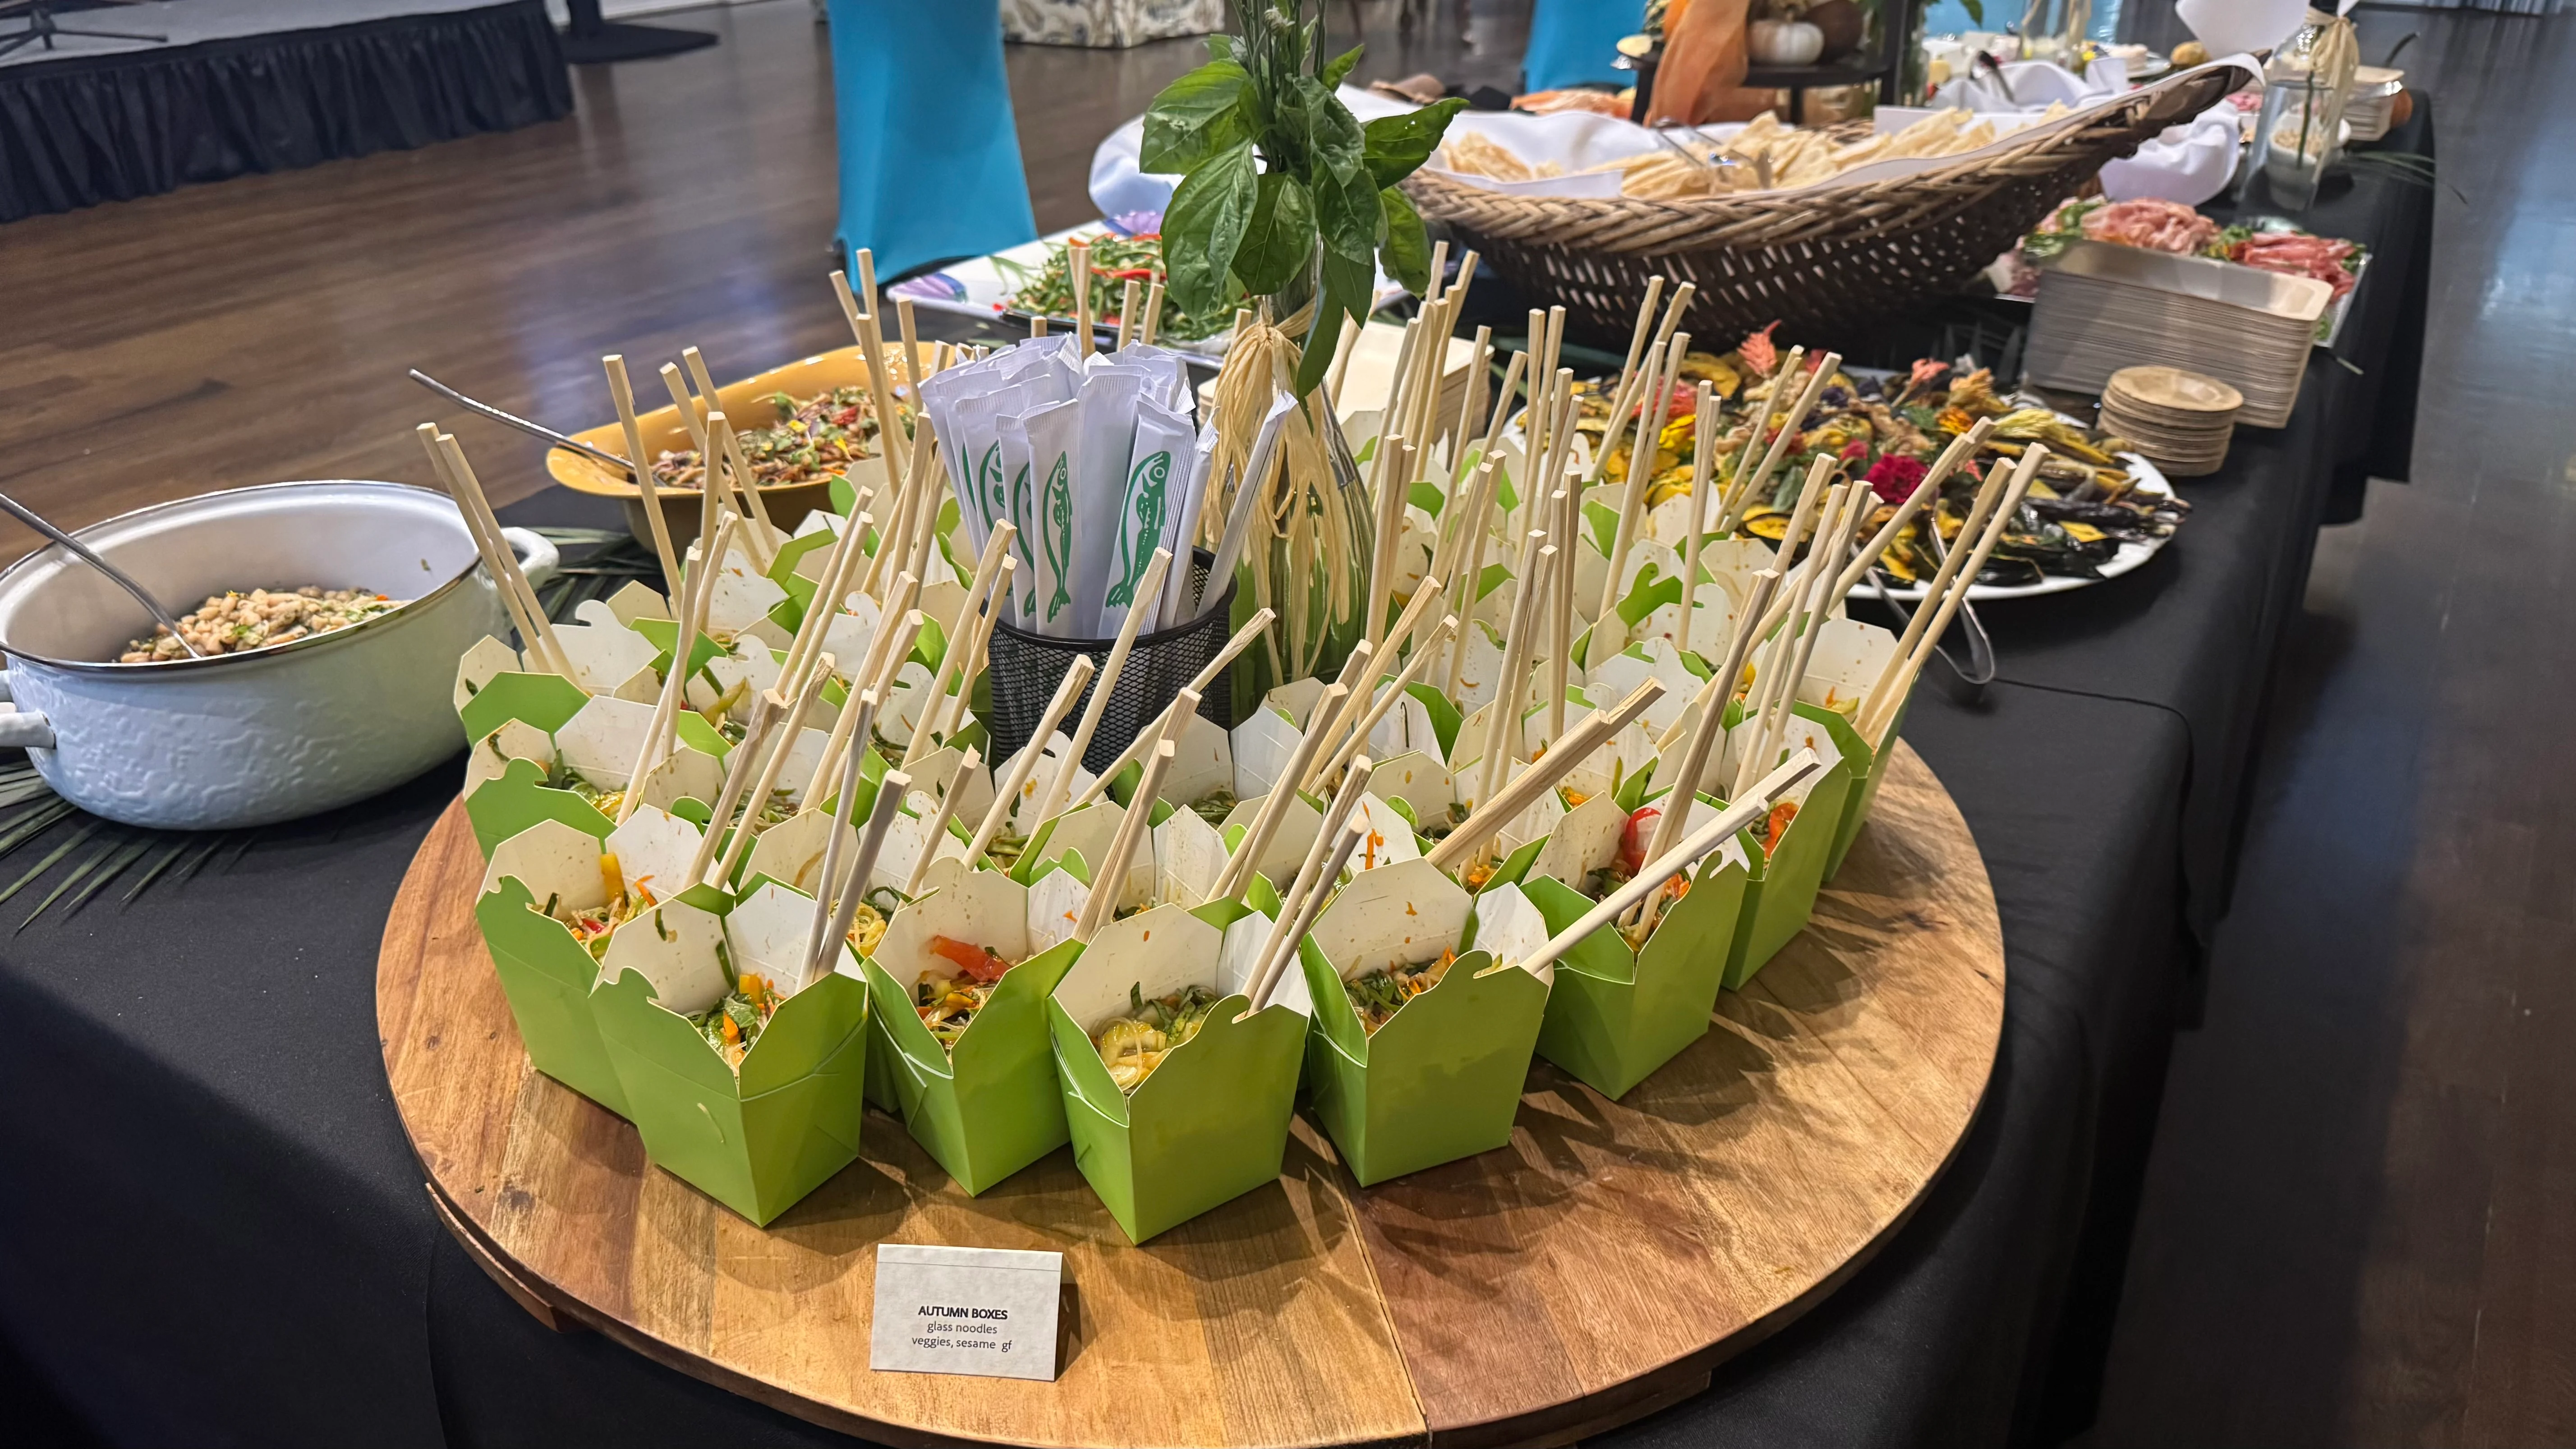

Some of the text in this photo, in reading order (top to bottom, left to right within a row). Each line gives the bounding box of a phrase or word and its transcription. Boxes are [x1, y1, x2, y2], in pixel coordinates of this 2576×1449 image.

[918, 1306, 1008, 1320] AUTUMN BOXES
[927, 1321, 998, 1334] glass noodles
[911, 1337, 1012, 1353] veggies, sesame gf
